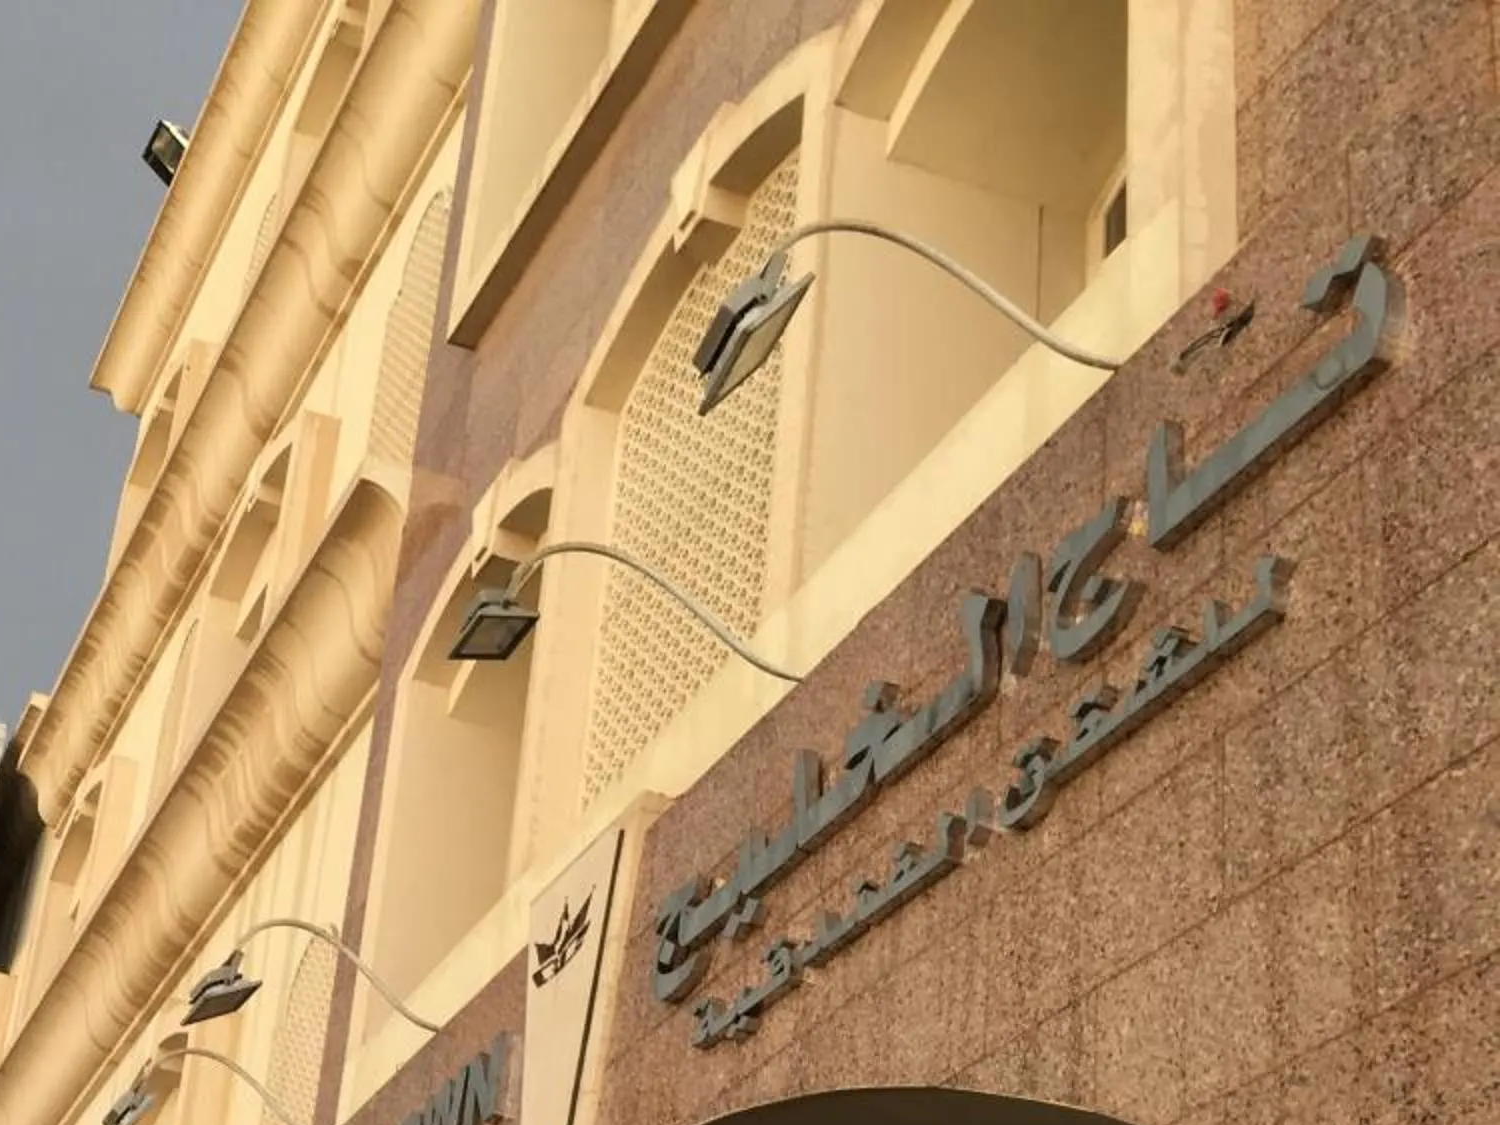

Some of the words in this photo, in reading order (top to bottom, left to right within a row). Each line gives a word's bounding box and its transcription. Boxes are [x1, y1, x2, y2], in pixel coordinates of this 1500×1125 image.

[1050, 236, 1392, 662] تاج
[654, 552, 1042, 1002] الخليج
[1000, 556, 1290, 830] للشقق
[694, 788, 992, 1048] الفندقية
